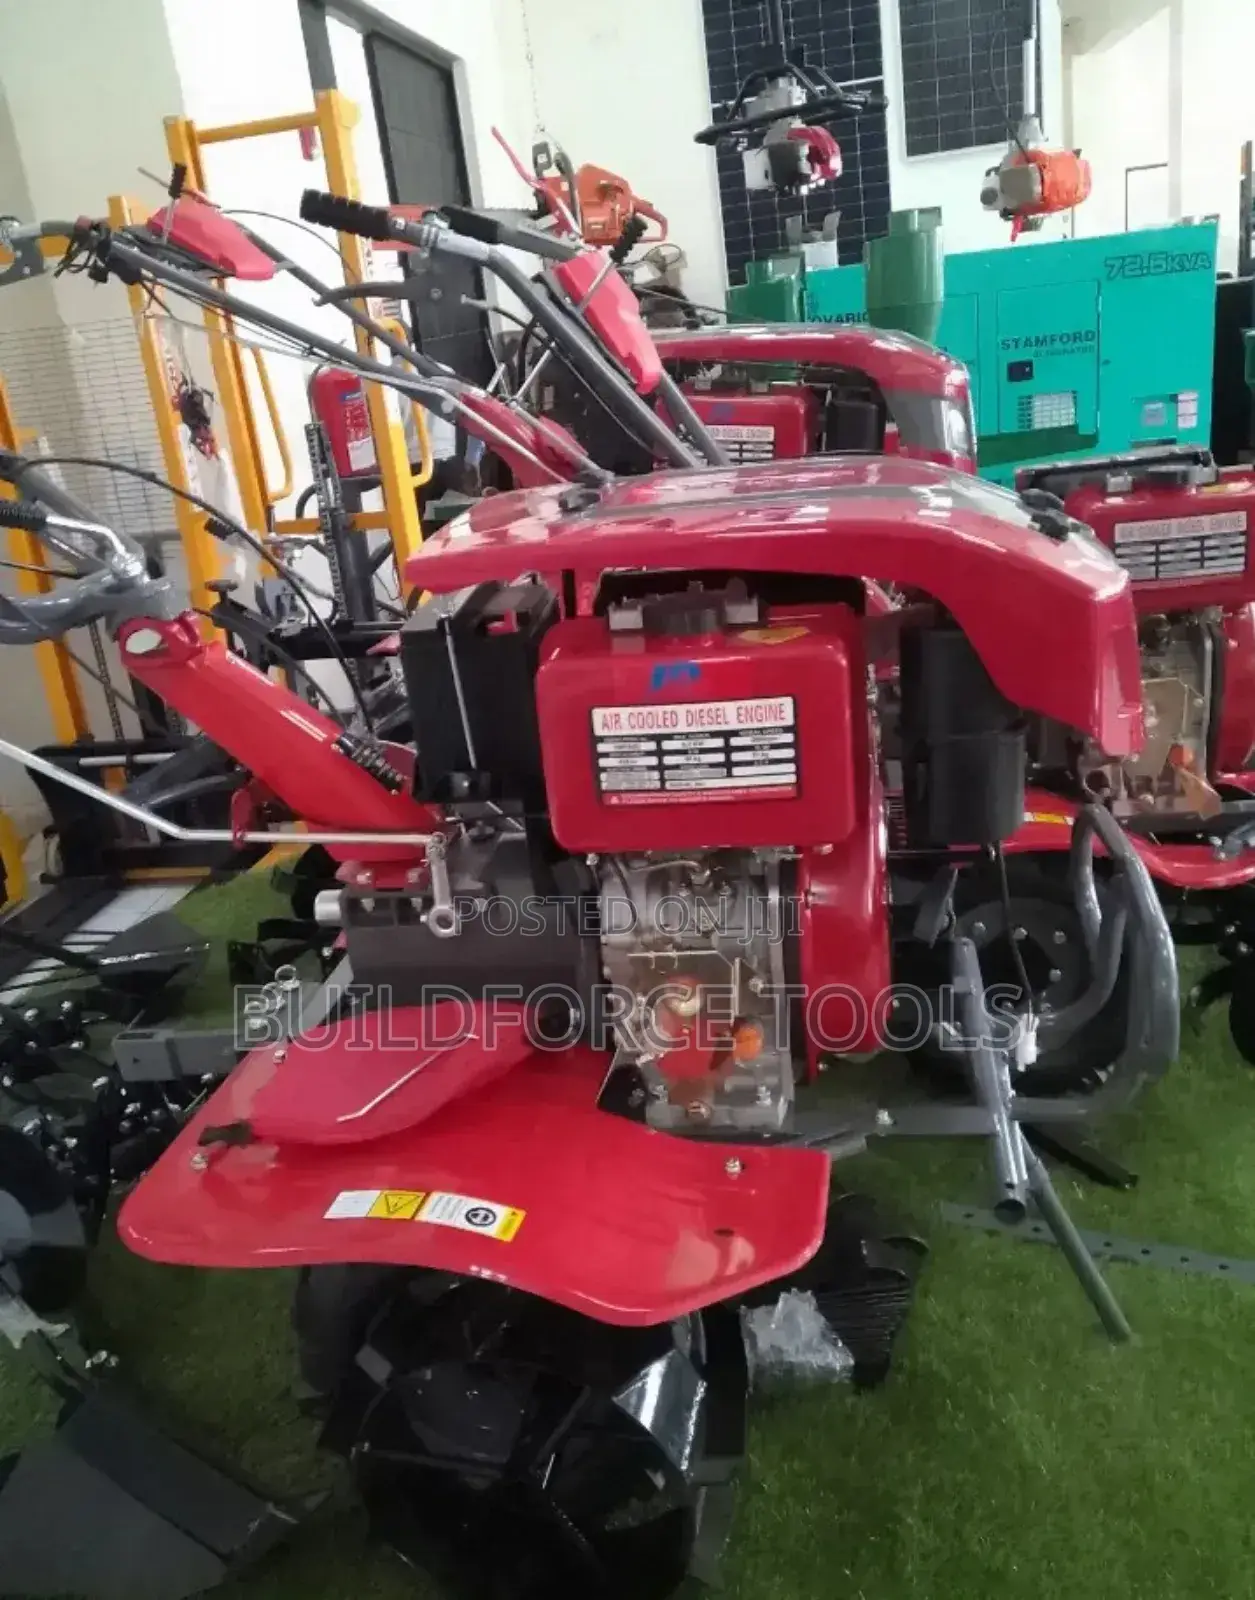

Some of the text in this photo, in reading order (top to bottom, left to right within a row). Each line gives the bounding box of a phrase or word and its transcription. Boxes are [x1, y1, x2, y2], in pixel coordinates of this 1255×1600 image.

[1001, 329, 1096, 351] STAMFORD
[601, 703, 787, 732] AIR COOLED DIESEL ENGINE
